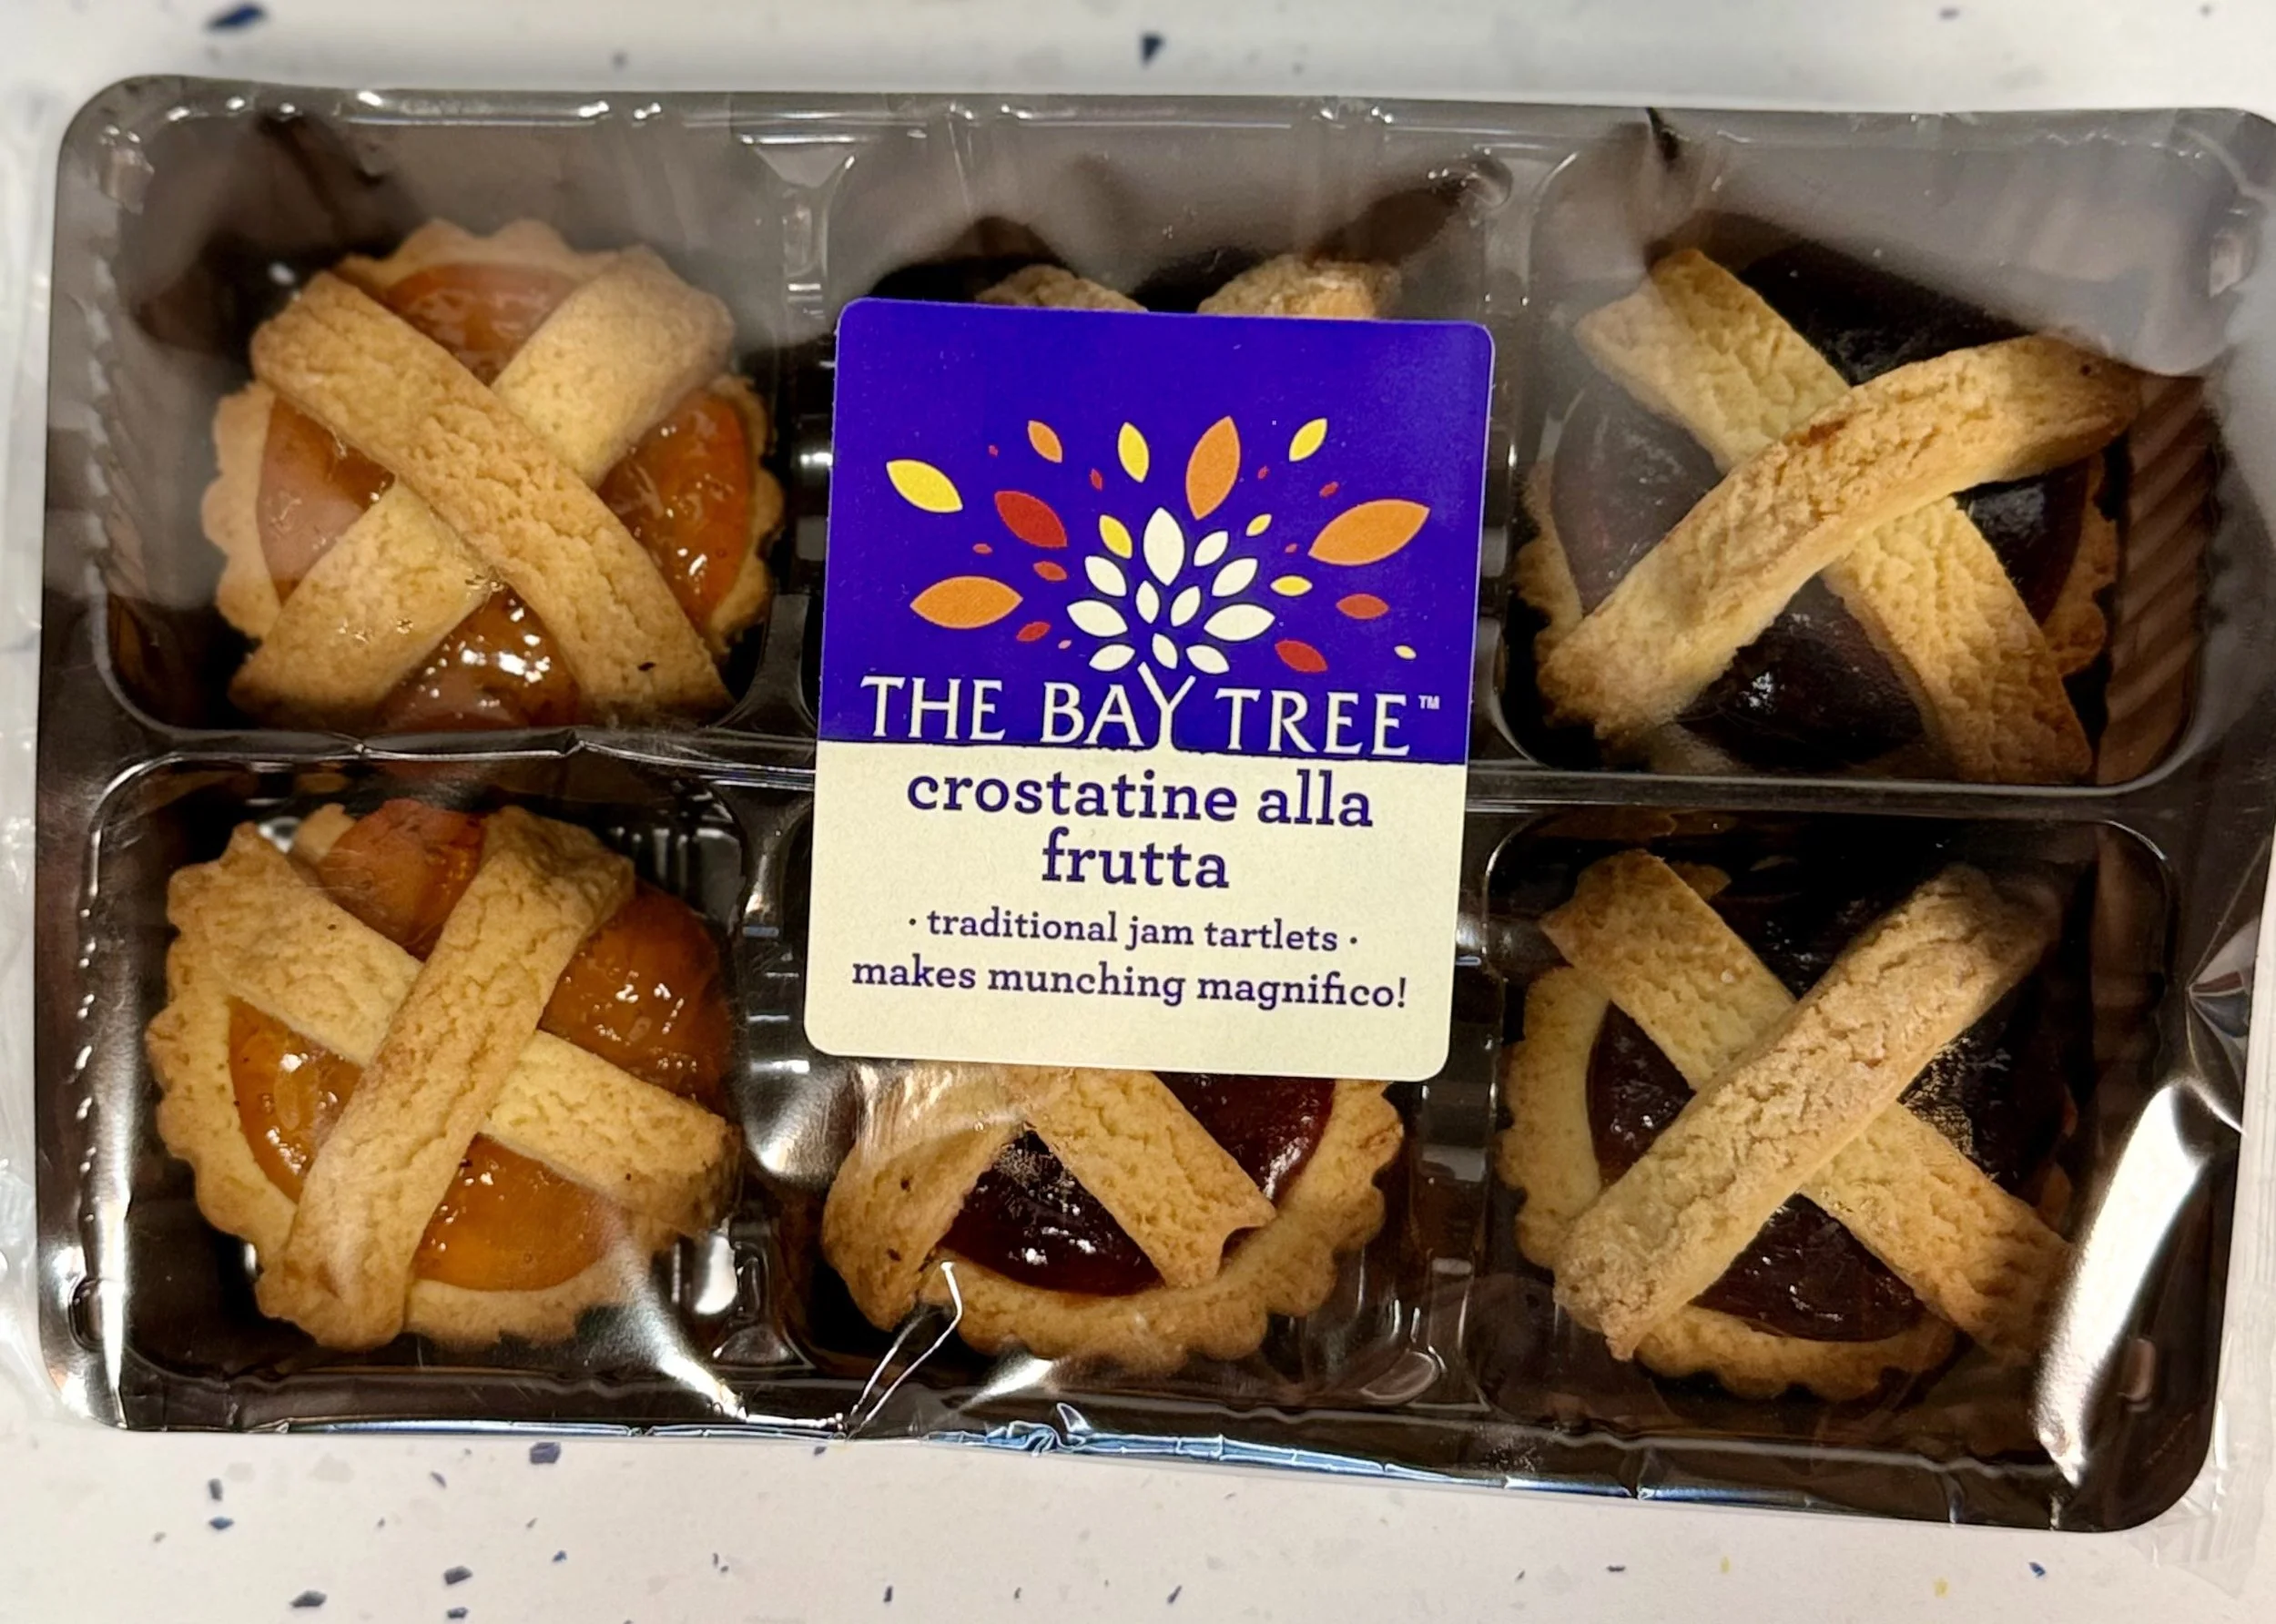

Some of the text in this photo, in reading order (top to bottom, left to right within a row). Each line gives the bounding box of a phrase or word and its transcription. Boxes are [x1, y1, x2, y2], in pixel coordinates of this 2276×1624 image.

[861, 675, 1006, 742] THE
[1040, 662, 1196, 752] BAY
[908, 769, 1373, 827] crostatine alla
[1041, 827, 1229, 888] frutta
[927, 907, 1338, 952] traditional jam tartlets
[851, 952, 1407, 1011] makes munching magnifico!
